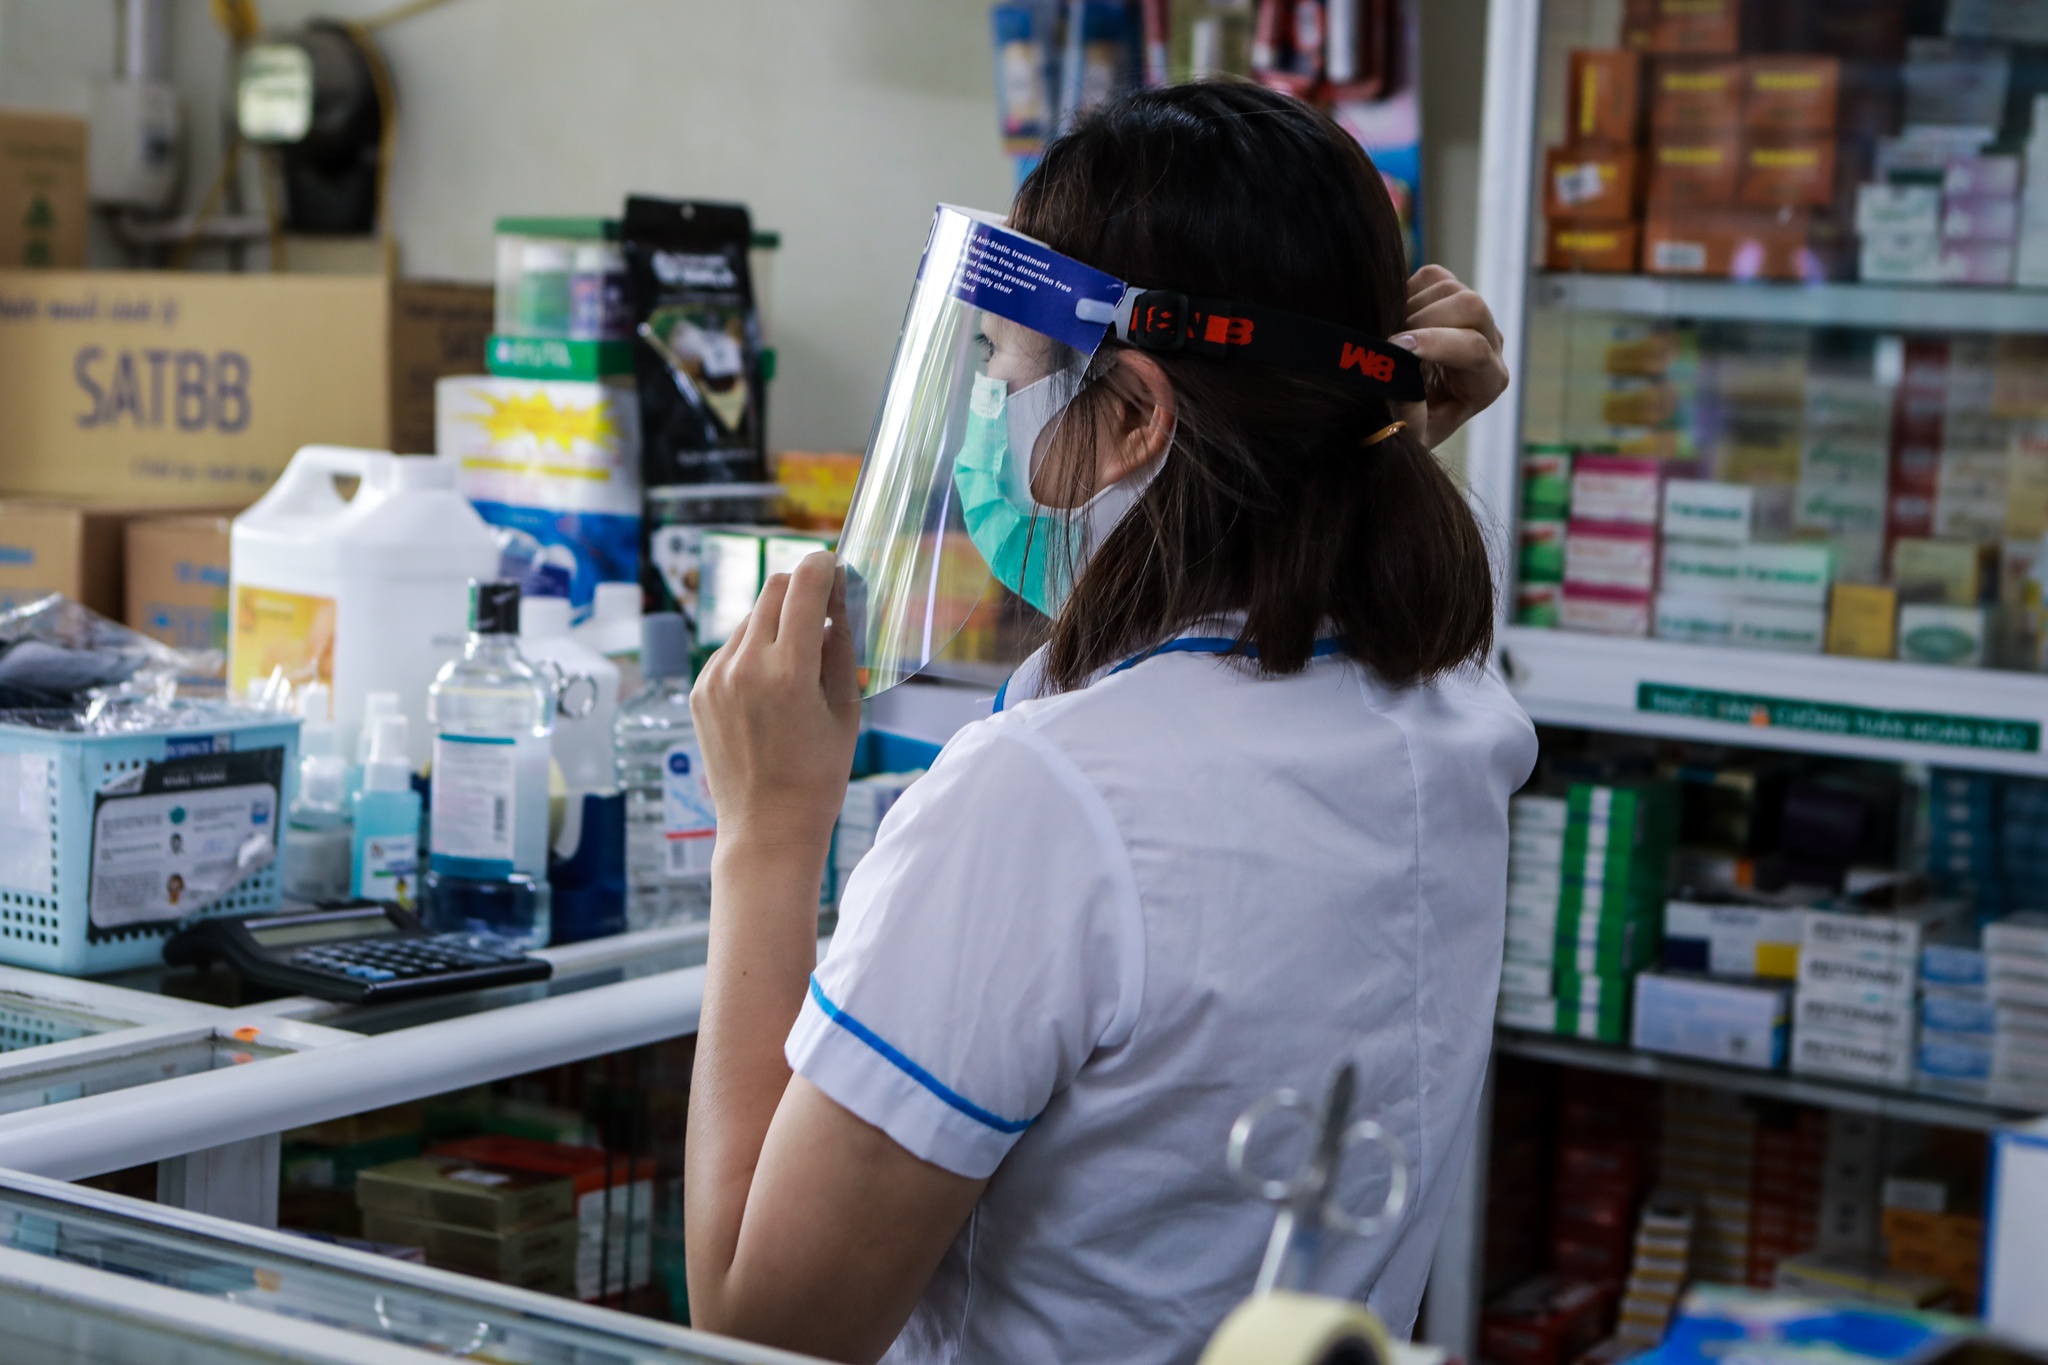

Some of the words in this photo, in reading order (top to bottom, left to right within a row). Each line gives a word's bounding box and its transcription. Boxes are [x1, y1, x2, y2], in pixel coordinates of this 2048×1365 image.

[976, 235, 1011, 255] Anti-Static
[1011, 249, 1051, 272] treatment
[965, 270, 994, 289] Optically
[993, 281, 1014, 295] clear
[976, 261, 1003, 279] relieves
[1003, 273, 1037, 292] pressure
[998, 257, 1016, 271] free,
[1016, 265, 1055, 287] distortion
[1054, 280, 1073, 294] free
